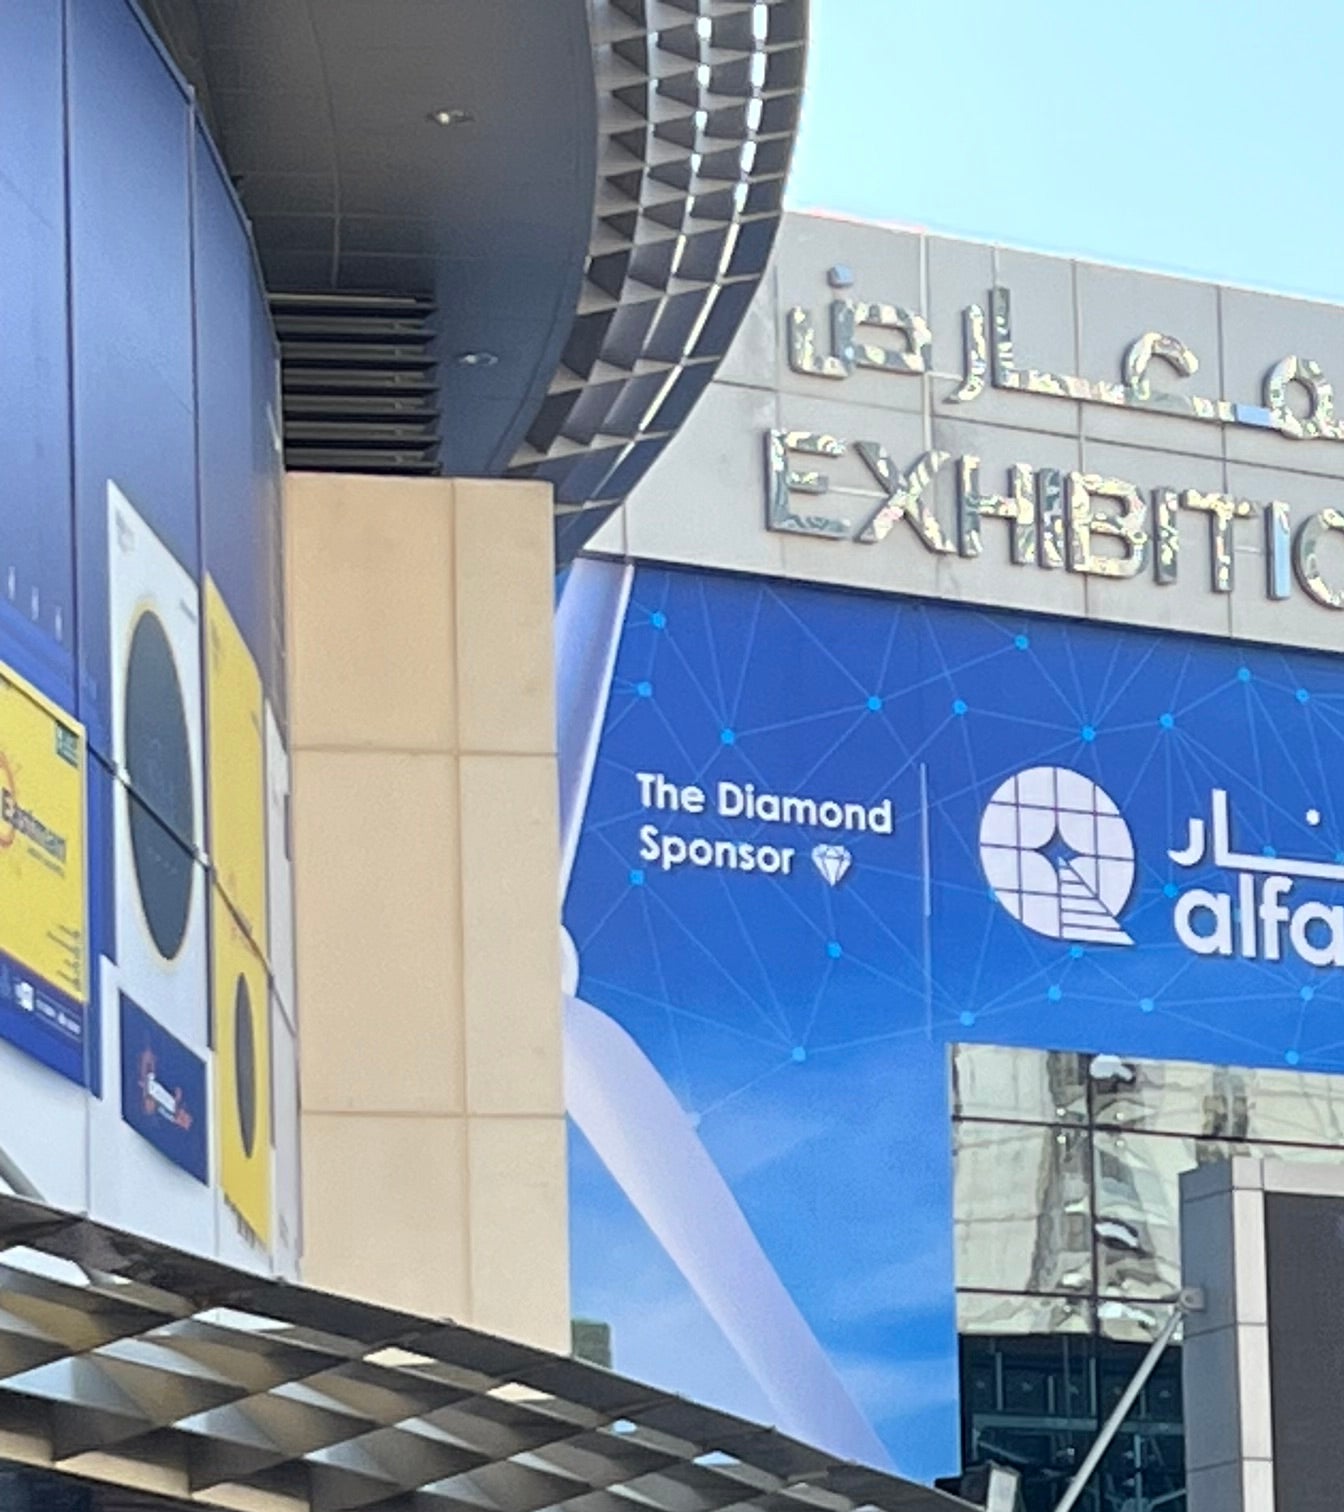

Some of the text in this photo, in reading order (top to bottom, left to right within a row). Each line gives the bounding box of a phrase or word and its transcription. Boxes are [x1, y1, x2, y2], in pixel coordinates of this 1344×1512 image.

[636, 773, 893, 834] The Diamond
[639, 826, 795, 877] Sponsor
